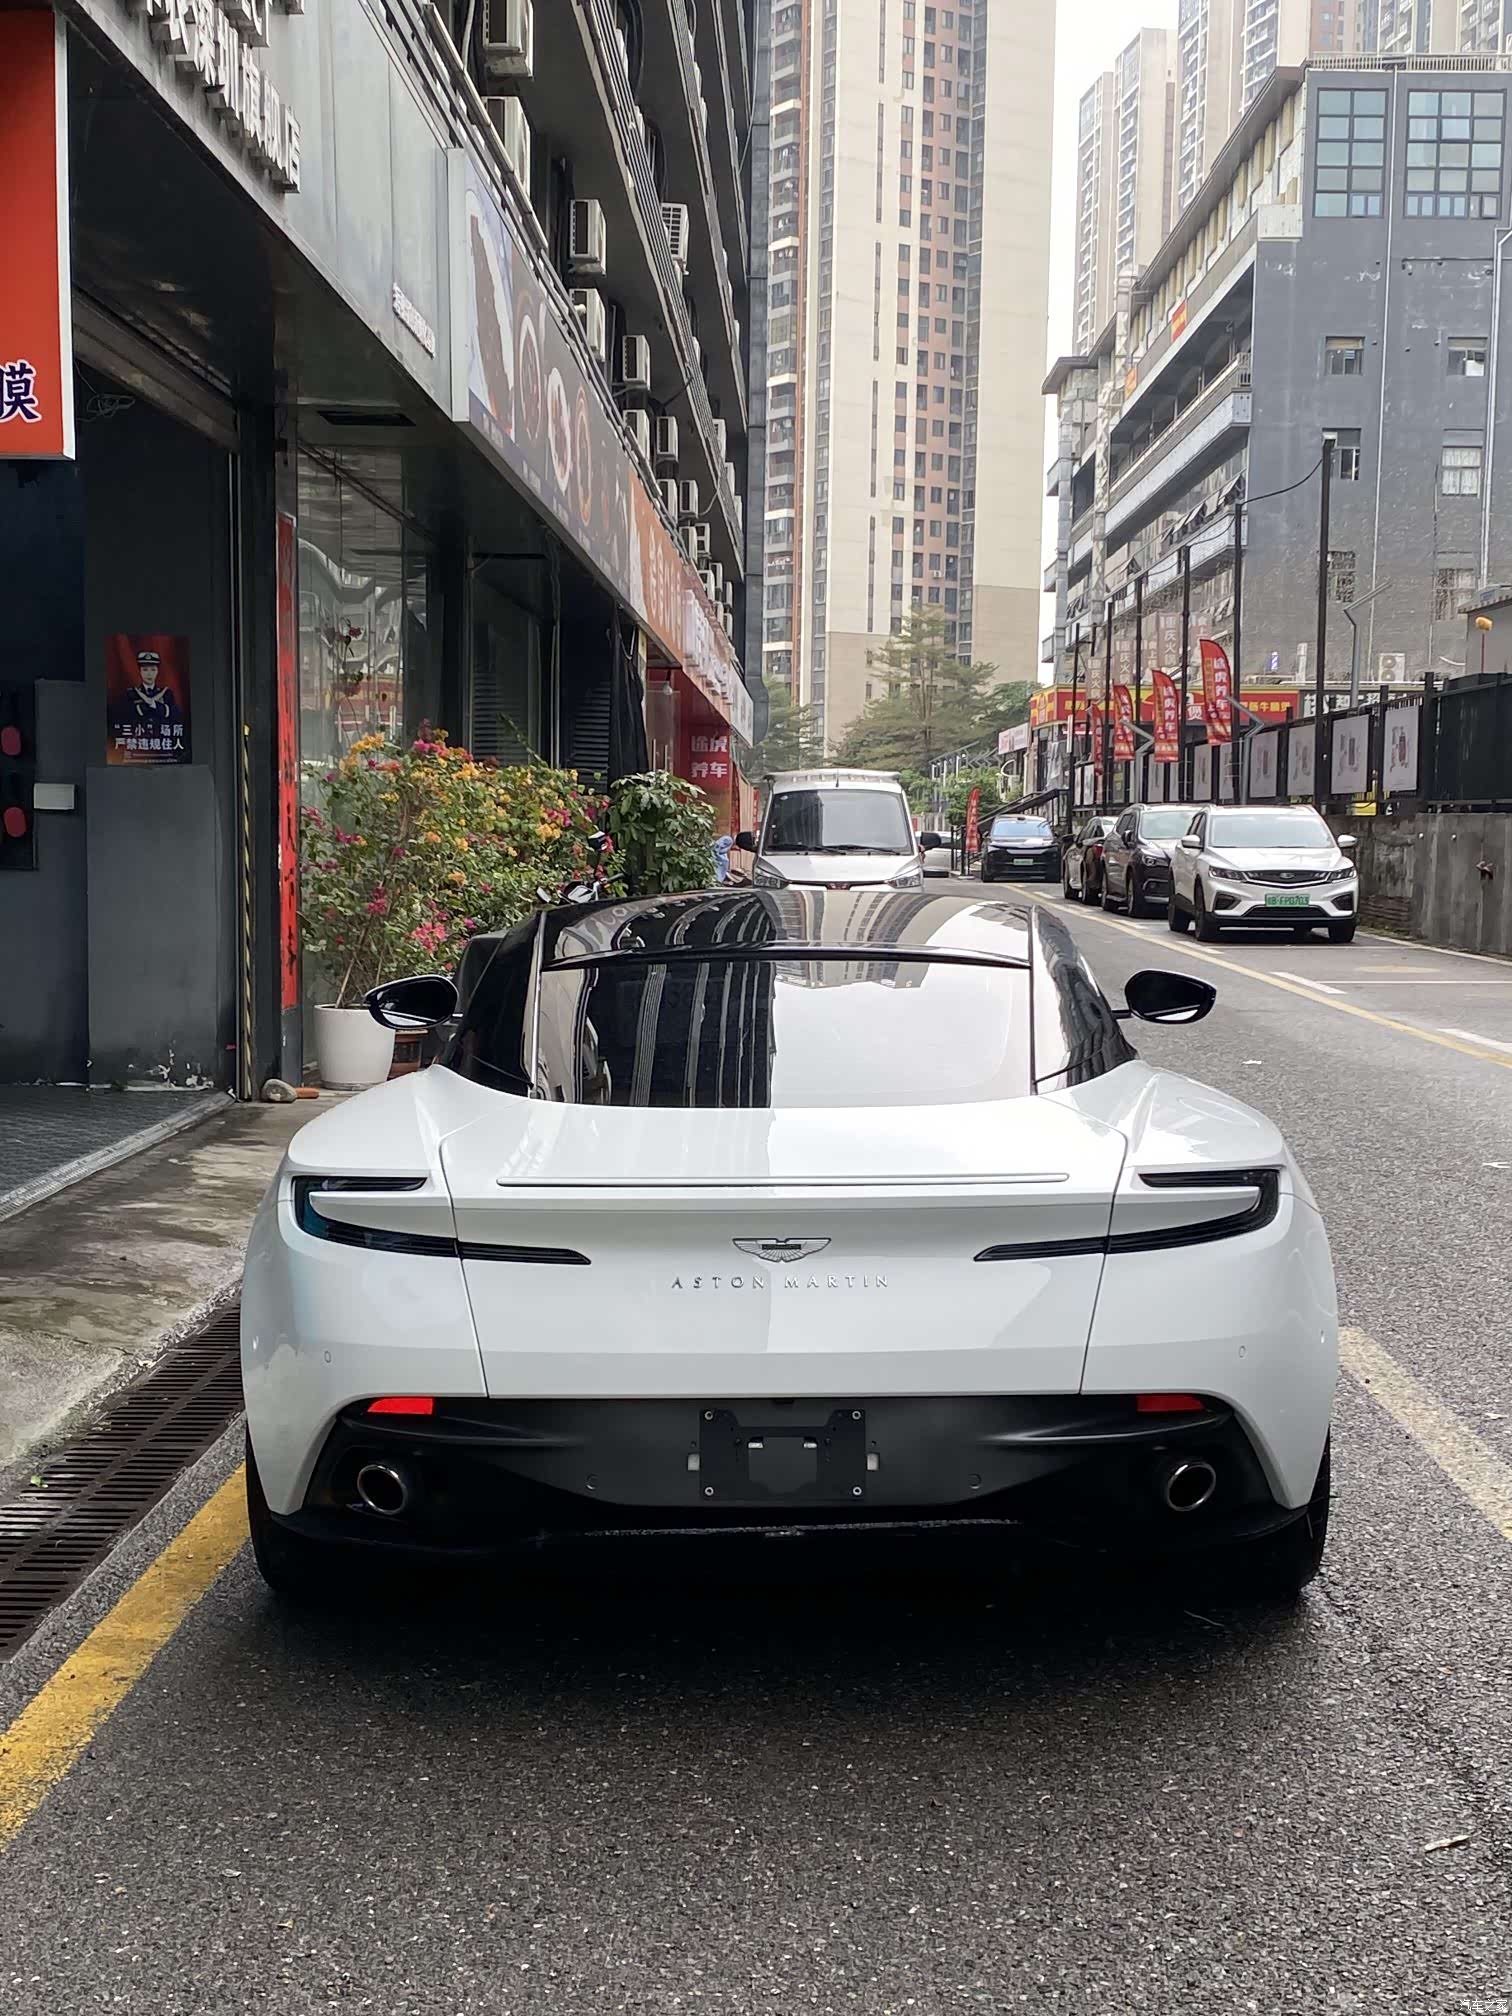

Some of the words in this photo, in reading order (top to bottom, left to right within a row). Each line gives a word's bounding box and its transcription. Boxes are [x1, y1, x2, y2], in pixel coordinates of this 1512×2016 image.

[115, 737, 184, 750] 严禁违规住人
[691, 736, 727, 753] 途虎
[691, 762, 727, 778] 养车
[671, 1276, 767, 1290] ASTON
[784, 1275, 889, 1289] MARTIN
